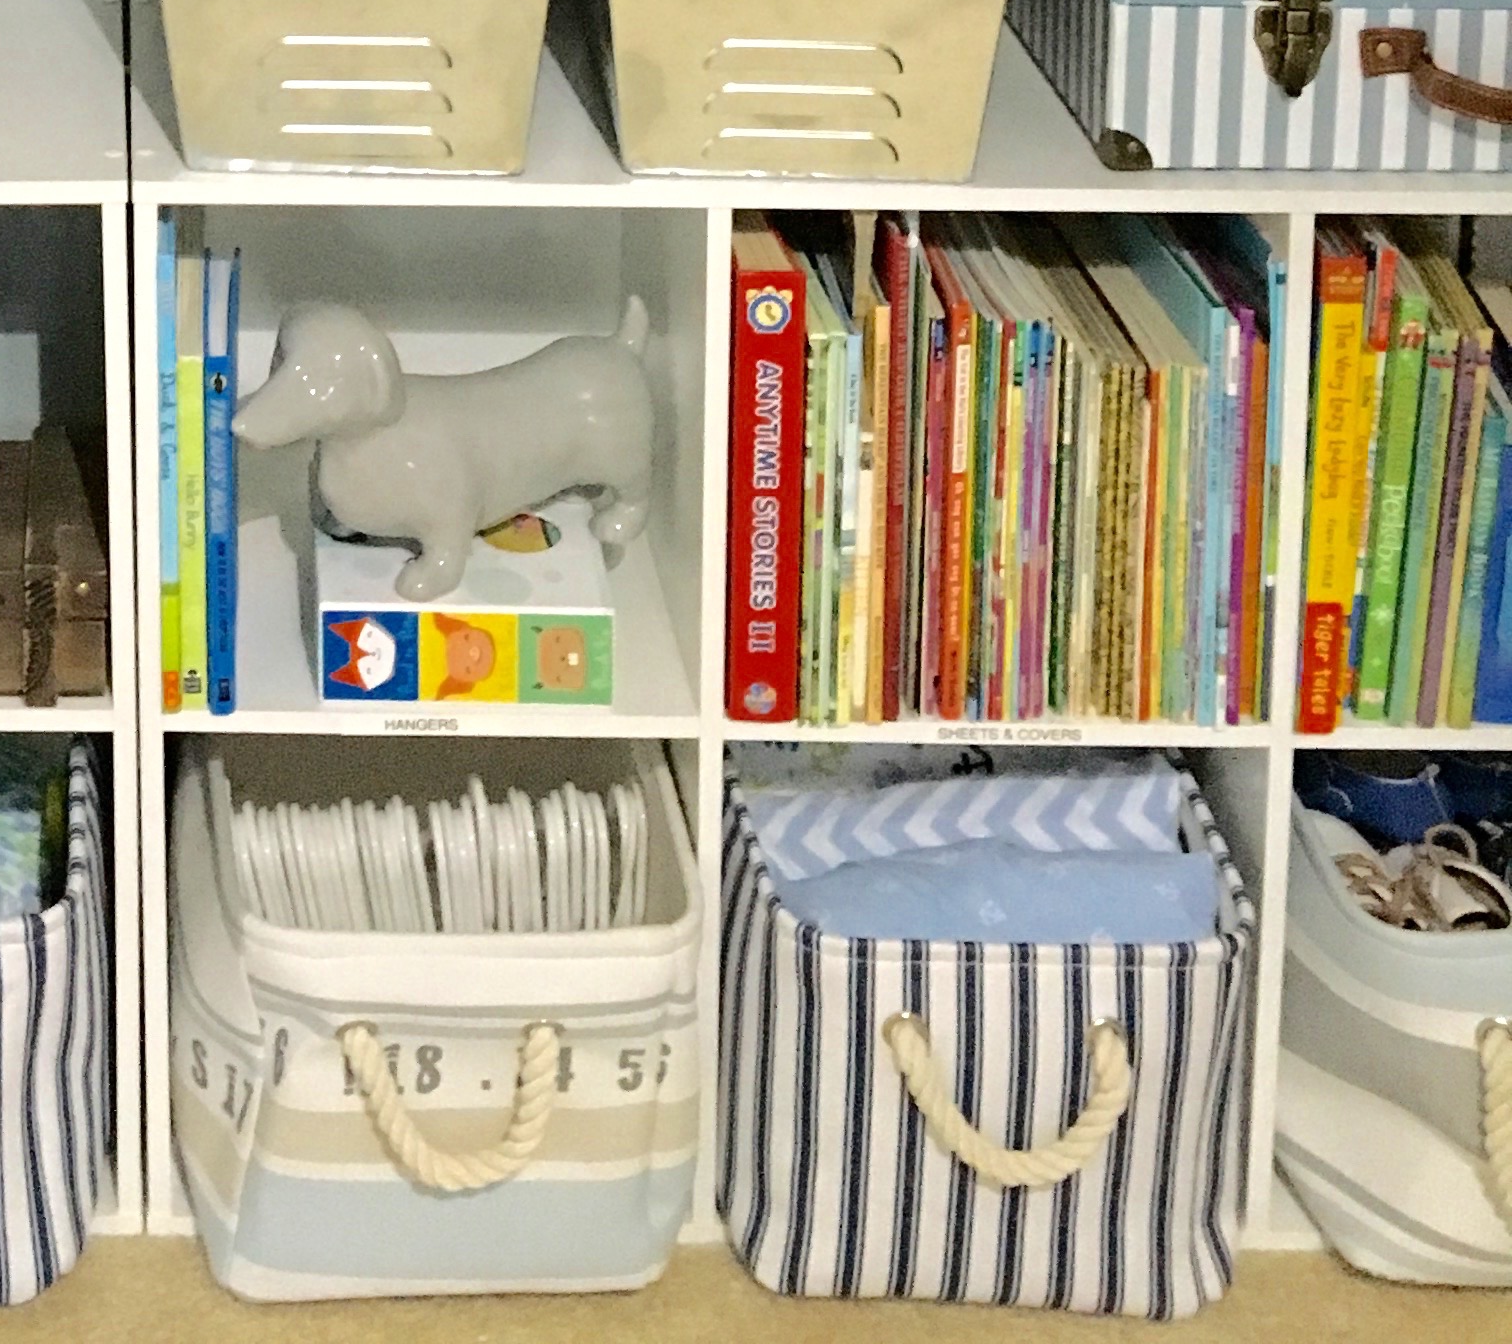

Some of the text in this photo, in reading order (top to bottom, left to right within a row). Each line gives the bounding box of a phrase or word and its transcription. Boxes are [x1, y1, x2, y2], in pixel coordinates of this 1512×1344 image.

[159, 372, 177, 412] Duck
[751, 360, 783, 490] ANYTIME
[1320, 320, 1356, 500] The Very Lazy Ladybug
[185, 473, 200, 506] Hello
[749, 496, 777, 610] STORIES
[1311, 613, 1335, 716] tiger tales
[384, 718, 459, 732] HANGERS
[937, 727, 1000, 740] SHEETS
[1017, 728, 1083, 741] COVERS
